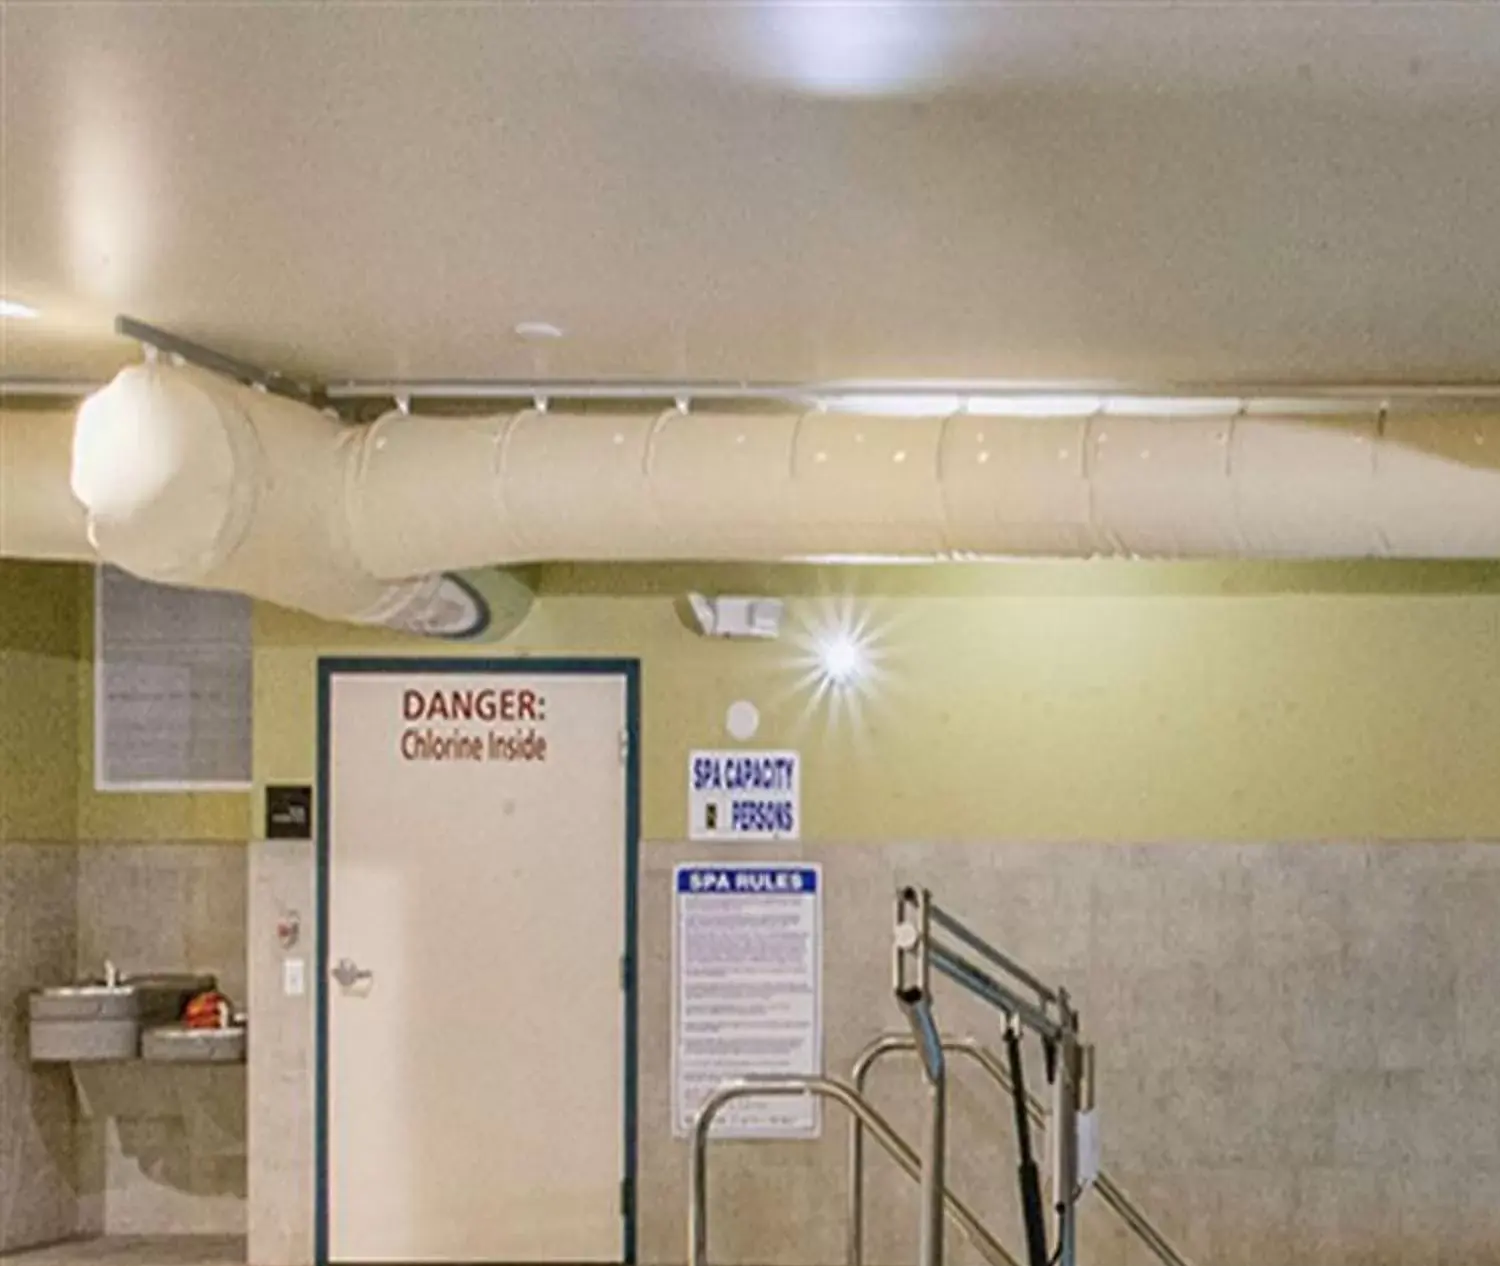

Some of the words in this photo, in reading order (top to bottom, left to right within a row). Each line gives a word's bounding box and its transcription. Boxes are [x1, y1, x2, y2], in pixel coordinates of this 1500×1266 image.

[403, 689, 545, 721] DANGER:
[401, 728, 483, 761] Chlorine
[488, 729, 547, 760] Inside
[694, 757, 720, 789] SPA
[725, 757, 794, 789] CAPACITY
[732, 800, 793, 832] PERSONS
[689, 872, 730, 890] SPA
[735, 872, 803, 890] RULES
